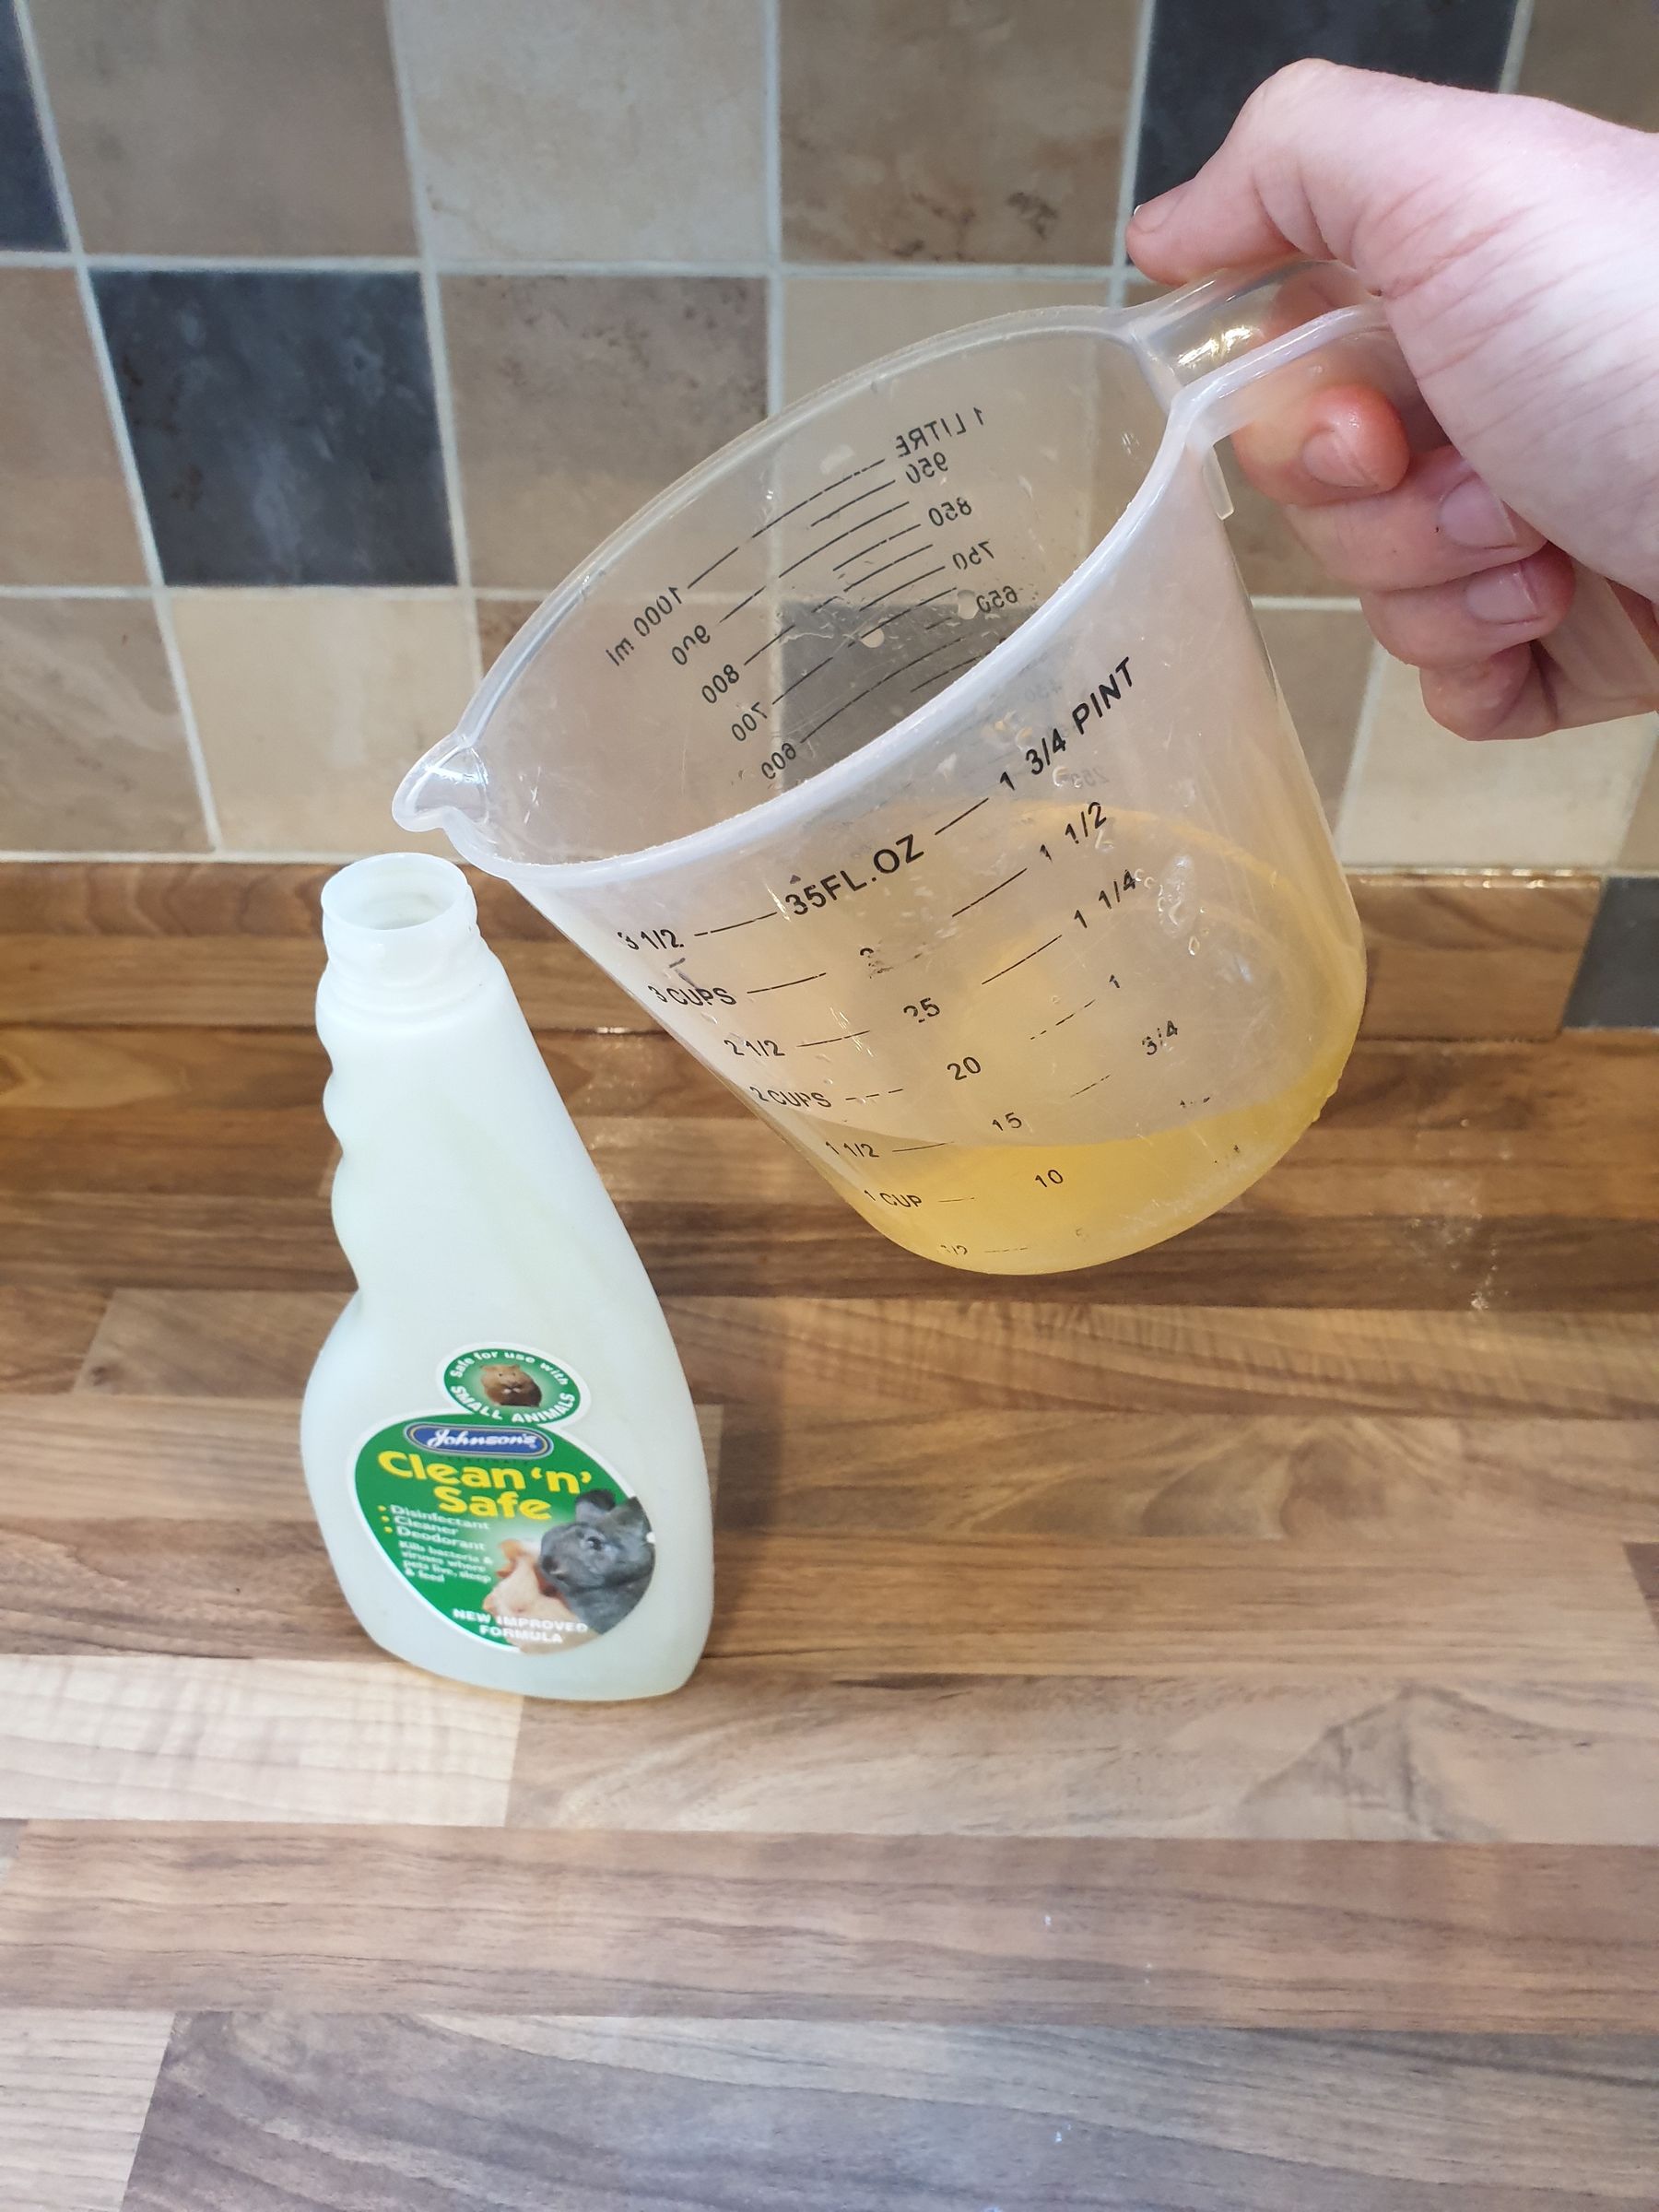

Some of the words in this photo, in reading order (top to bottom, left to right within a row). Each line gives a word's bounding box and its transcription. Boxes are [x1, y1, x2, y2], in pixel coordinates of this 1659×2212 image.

[999, 771, 1016, 792] 1
[1024, 727, 1067, 776] 3/4
[1071, 655, 1134, 735] PINT
[1064, 800, 1108, 845] 1/2
[1073, 909, 1088, 929] 1
[946, 1055, 982, 1081] 20
[991, 1111, 1023, 1132] 15
[1034, 1168, 1065, 1189] 10
[879, 1192, 923, 1208] CUP
[449, 1357, 476, 1379] Safe
[473, 1351, 499, 1360] for
[503, 1351, 535, 1364] use
[539, 1361, 570, 1386] with
[450, 1384, 503, 1420] SMALL
[511, 1392, 576, 1424] ANIMALS
[426, 1426, 538, 1449] Johnson's
[377, 1450, 526, 1491] Clean
[432, 1485, 552, 1522] Safe
[389, 1503, 490, 1531] Disinfectant
[394, 1515, 459, 1536] Cleaner
[396, 1525, 487, 1551] Deodorant
[452, 1607, 492, 1624] NEW
[496, 1615, 590, 1634] IMPROVED
[478, 1624, 564, 1644] FORMULA
